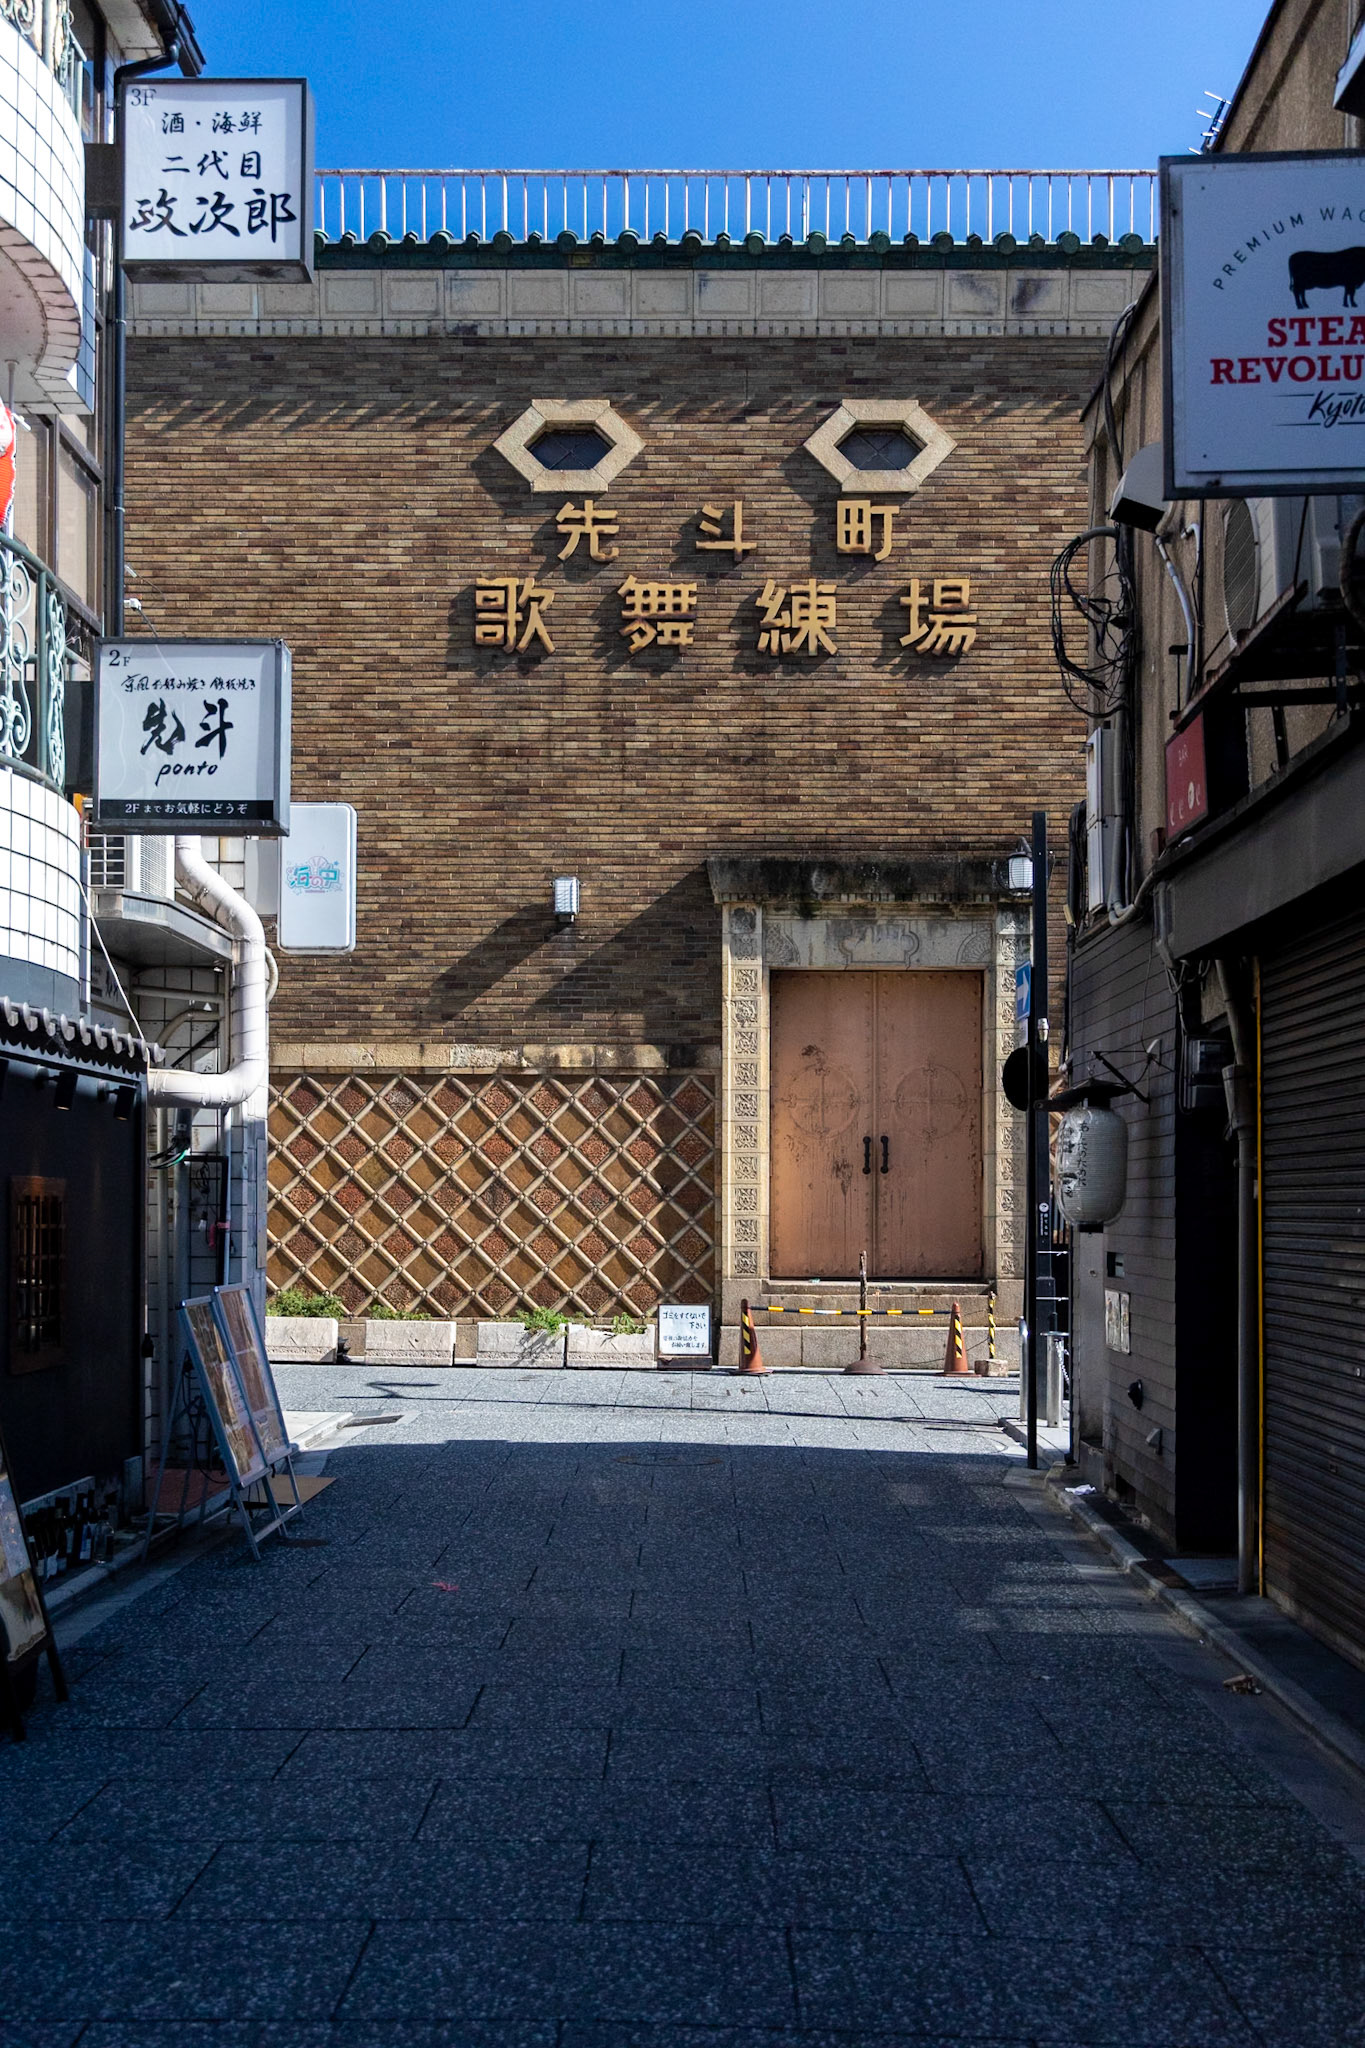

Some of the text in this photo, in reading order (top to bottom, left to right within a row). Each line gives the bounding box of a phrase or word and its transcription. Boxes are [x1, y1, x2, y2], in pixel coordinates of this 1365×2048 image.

[130, 88, 157, 106] 3F
[162, 112, 262, 135] 酒・海鮮
[162, 151, 262, 180] 二代目
[129, 188, 297, 243] 政次郎
[1213, 213, 1304, 290] PREMIUM
[1267, 316, 1365, 347] STEA
[1210, 354, 1364, 384] REVOLU
[556, 500, 899, 562] 先斗町
[475, 575, 977, 656] 歌舞練場
[108, 649, 131, 667] 2F
[140, 697, 234, 760] 先斗
[155, 761, 218, 786] ponto
